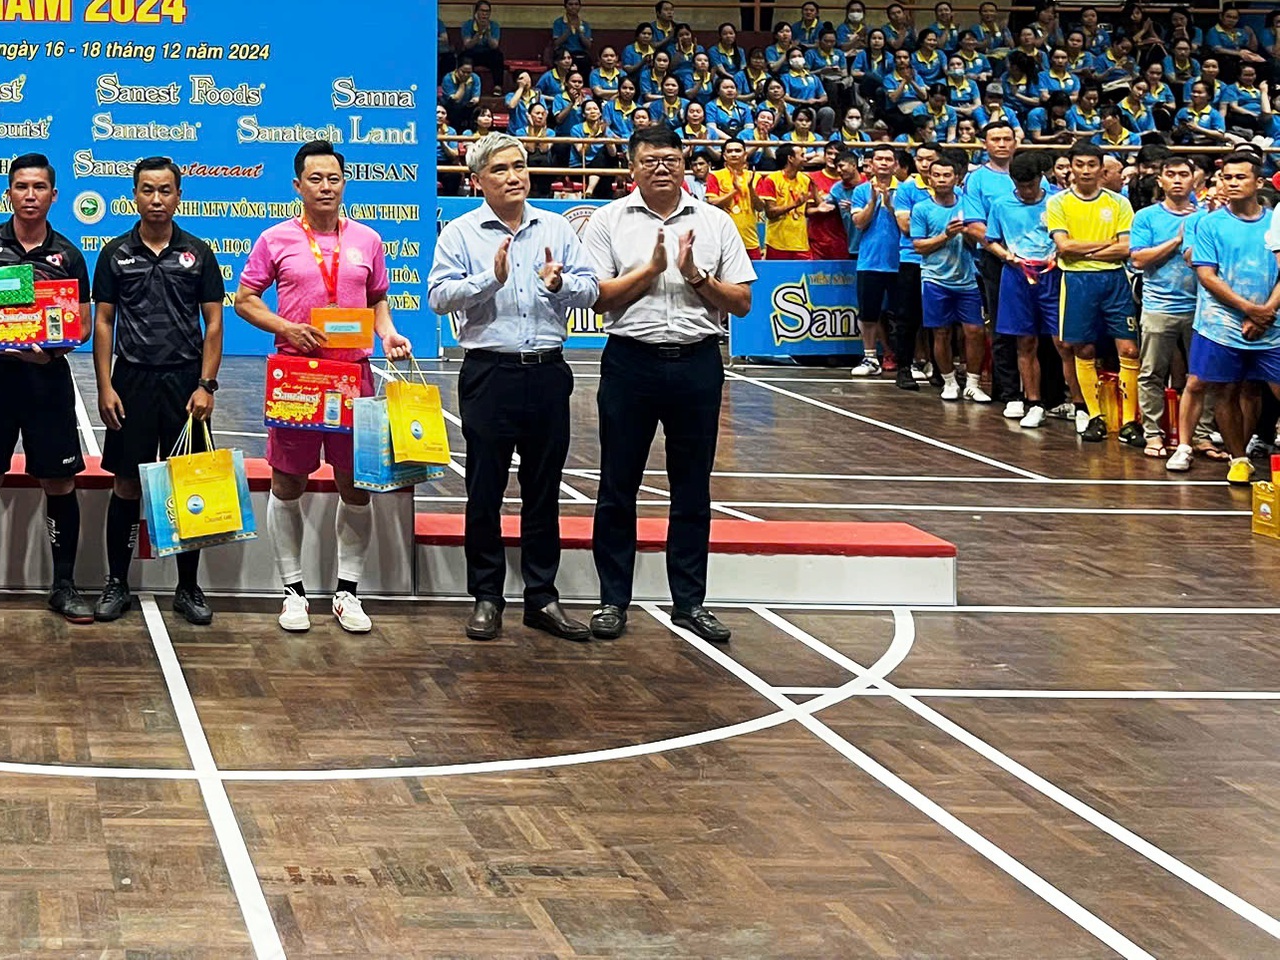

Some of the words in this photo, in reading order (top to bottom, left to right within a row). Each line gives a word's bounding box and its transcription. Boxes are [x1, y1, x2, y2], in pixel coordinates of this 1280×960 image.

[44, 41, 65, 58] 16
[81, 42, 101, 58] 18
[105, 42, 156, 63] tháng
[161, 43, 182, 59] 12
[185, 43, 224, 60] năm
[228, 44, 271, 60] 2024
[96, 73, 181, 106] Sanest
[189, 74, 265, 106] Foods
[332, 76, 417, 109] Sanna
[92, 111, 200, 141] Sanatech
[237, 115, 344, 144] Sanatech
[349, 115, 419, 144] Land
[73, 148, 143, 179] Sanes
[180, 162, 265, 179] staurant
[343, 162, 419, 182] SHSAN
[111, 196, 138, 217] CÔN
[173, 201, 202, 217] NHH
[202, 201, 232, 218] MTV
[232, 196, 267, 219] NÔNG
[267, 197, 305, 219] TRƯỜ
[350, 204, 378, 220] CAM
[378, 205, 420, 224] THỊNH
[222, 238, 251, 258] HỌC
[400, 238, 420, 258] ÁN
[391, 264, 421, 284] HÒA
